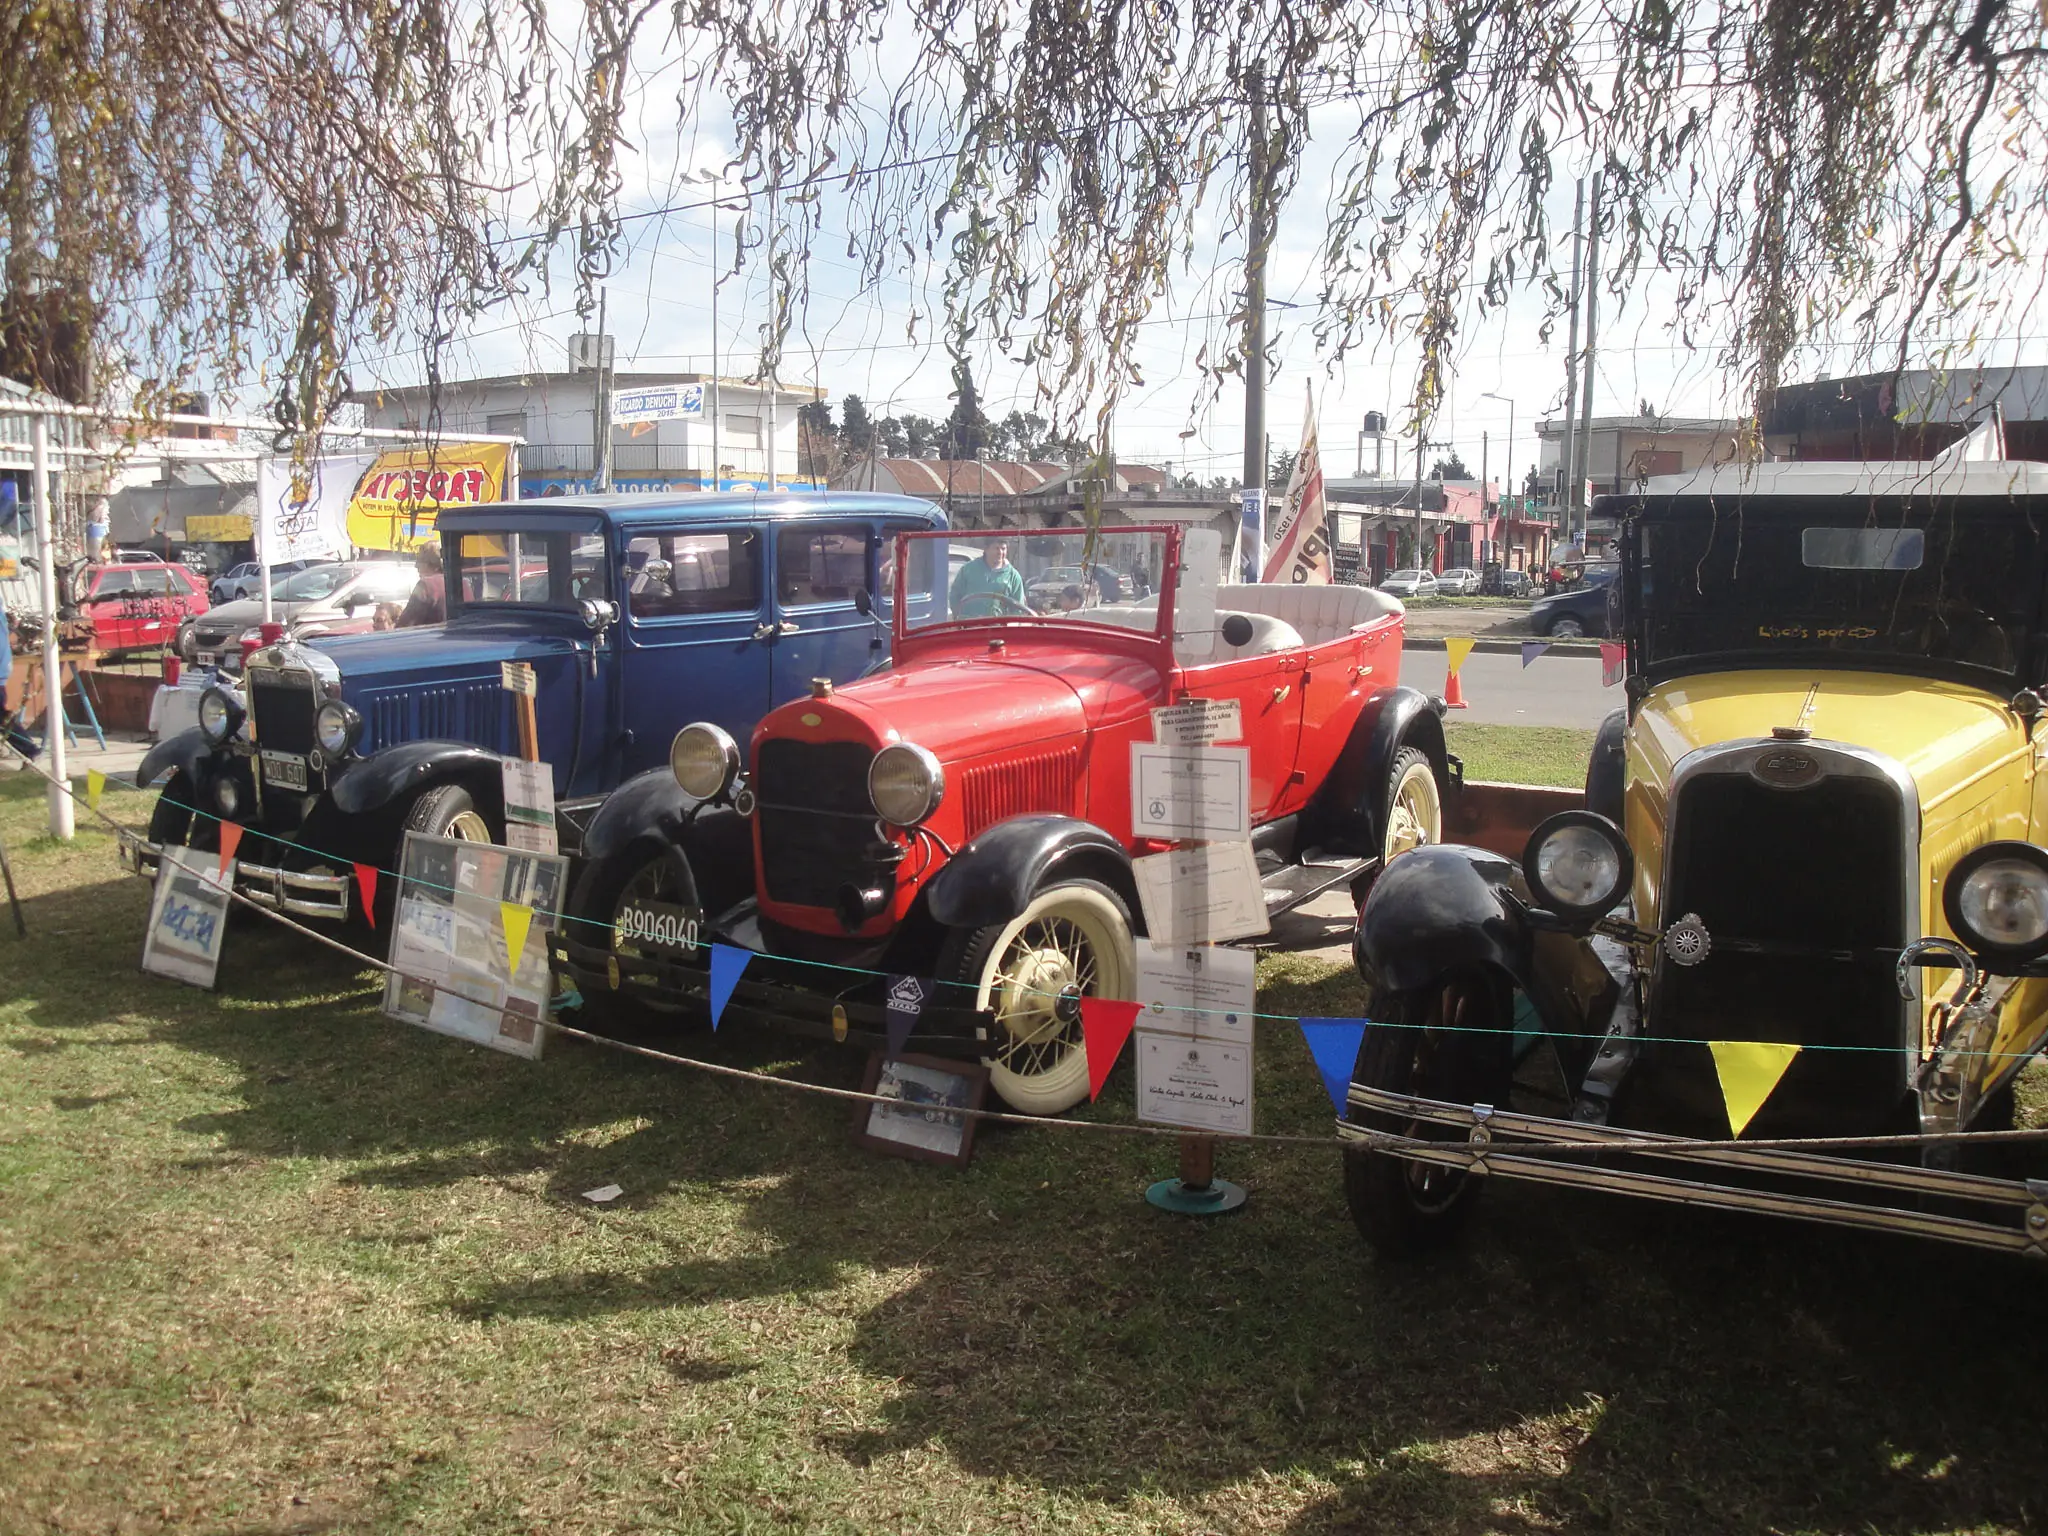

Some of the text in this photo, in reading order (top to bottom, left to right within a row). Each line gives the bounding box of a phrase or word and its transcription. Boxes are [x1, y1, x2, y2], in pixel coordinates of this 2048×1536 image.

[620, 398, 644, 413] RICARDO
[1816, 629, 1845, 638] por
[624, 906, 698, 951] B906040
